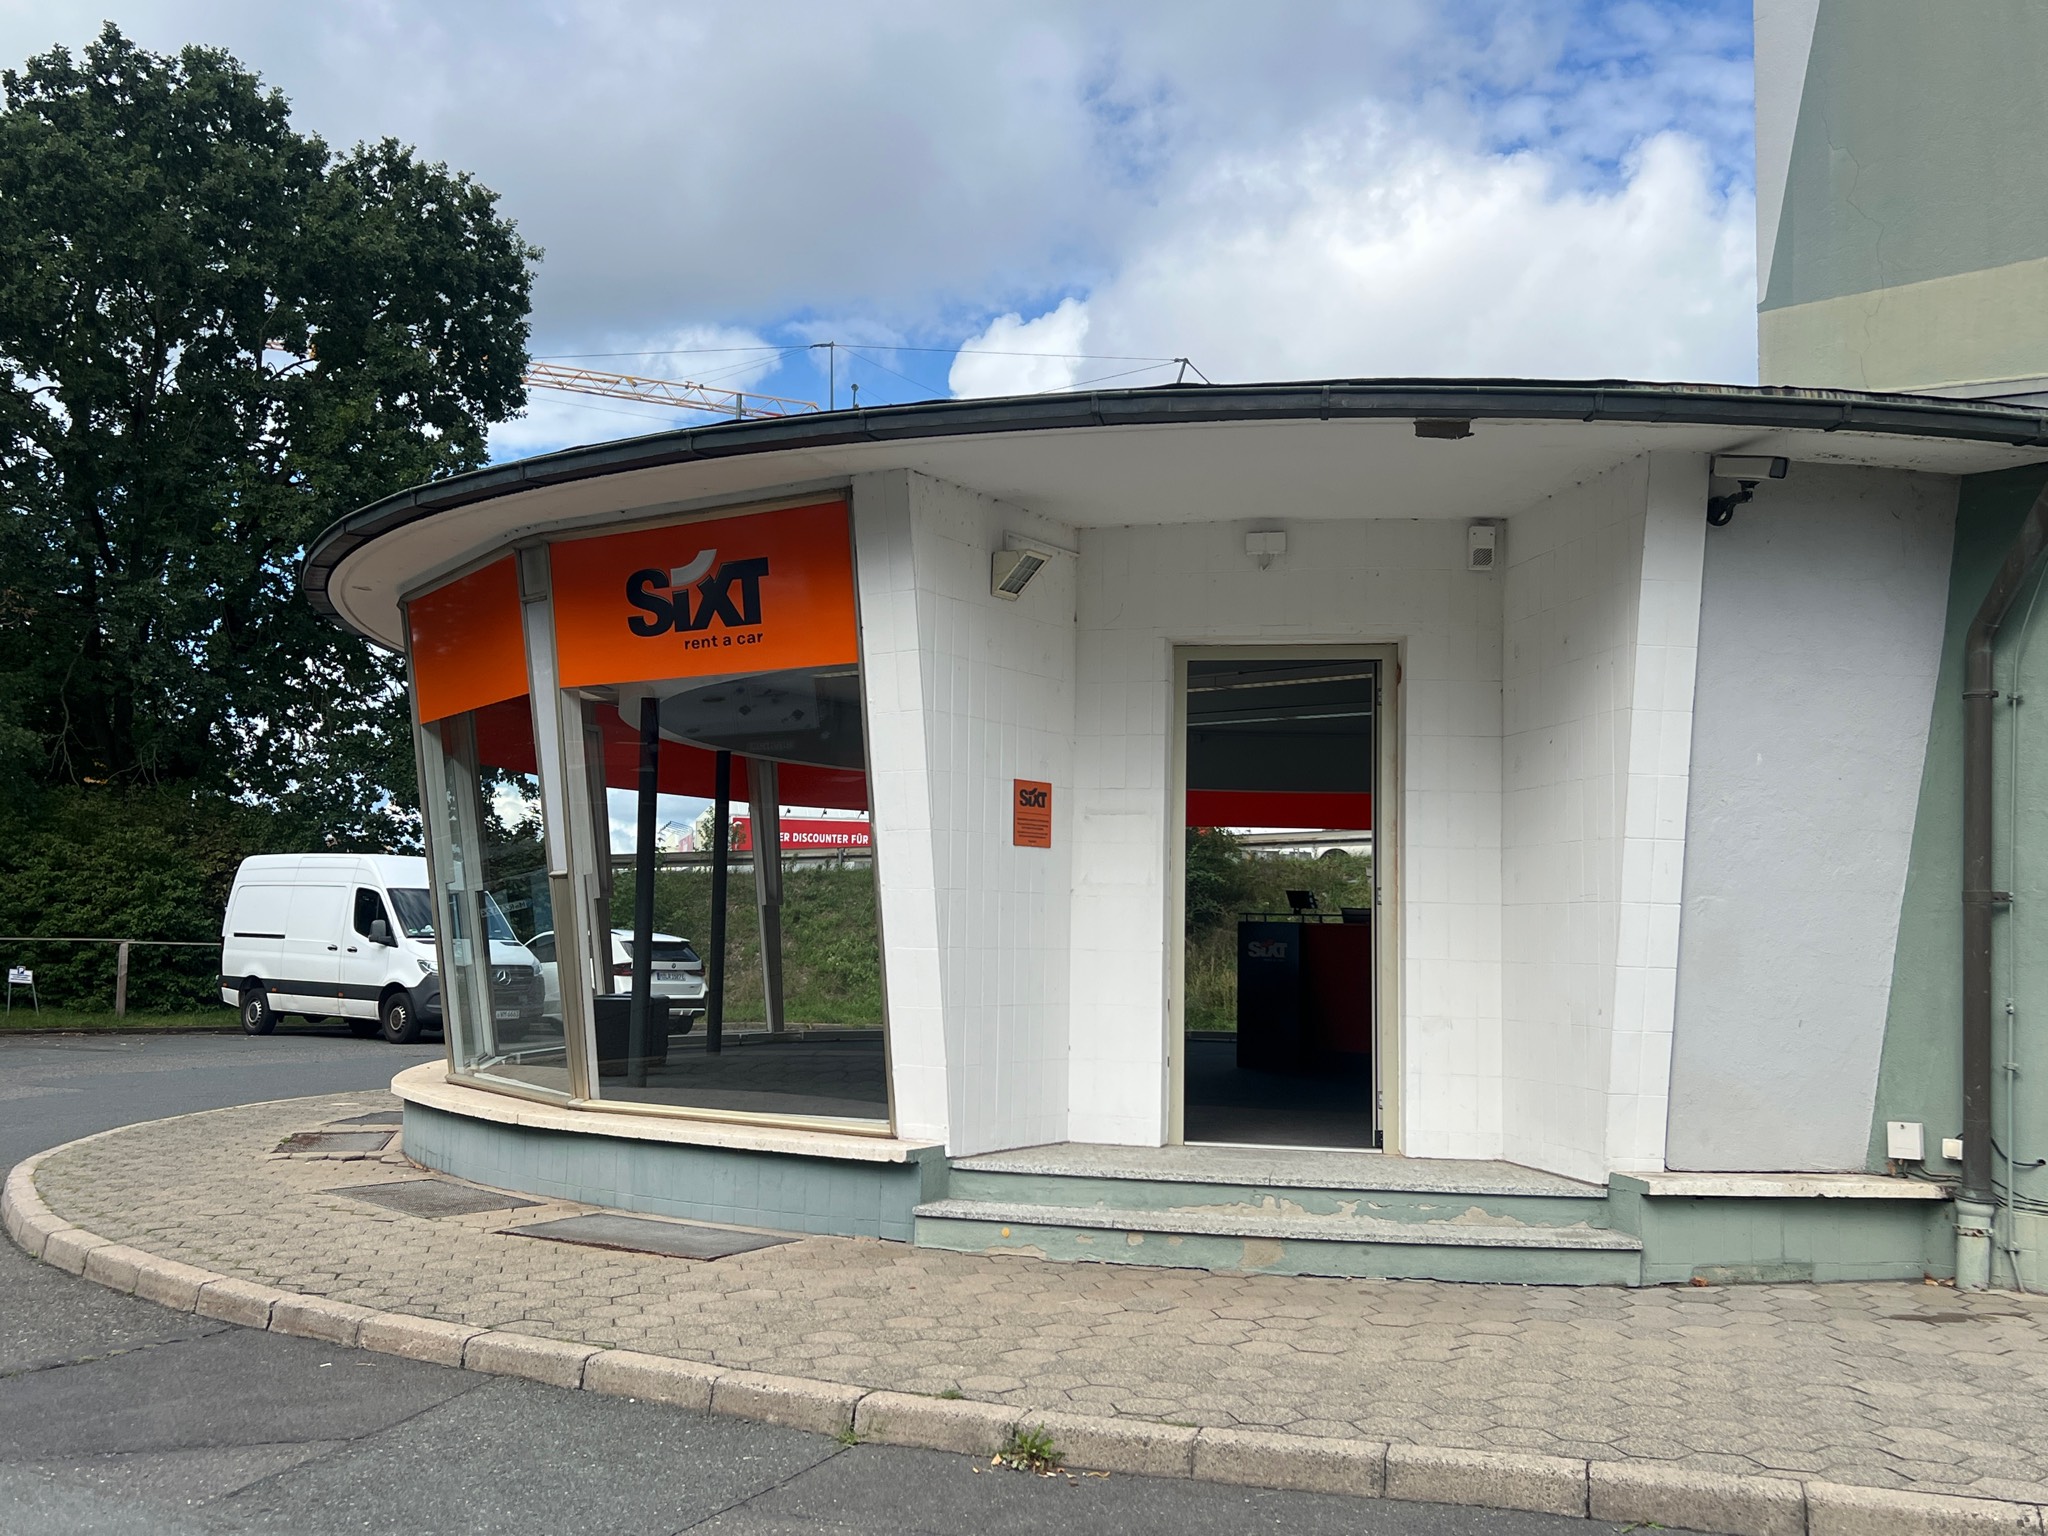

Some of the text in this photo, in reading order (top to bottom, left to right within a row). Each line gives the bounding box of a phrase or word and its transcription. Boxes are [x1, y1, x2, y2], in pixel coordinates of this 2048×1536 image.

[684, 633, 763, 650] rent a car
[793, 832, 849, 844] DISCOUNTER
[851, 833, 869, 844] FÜR
